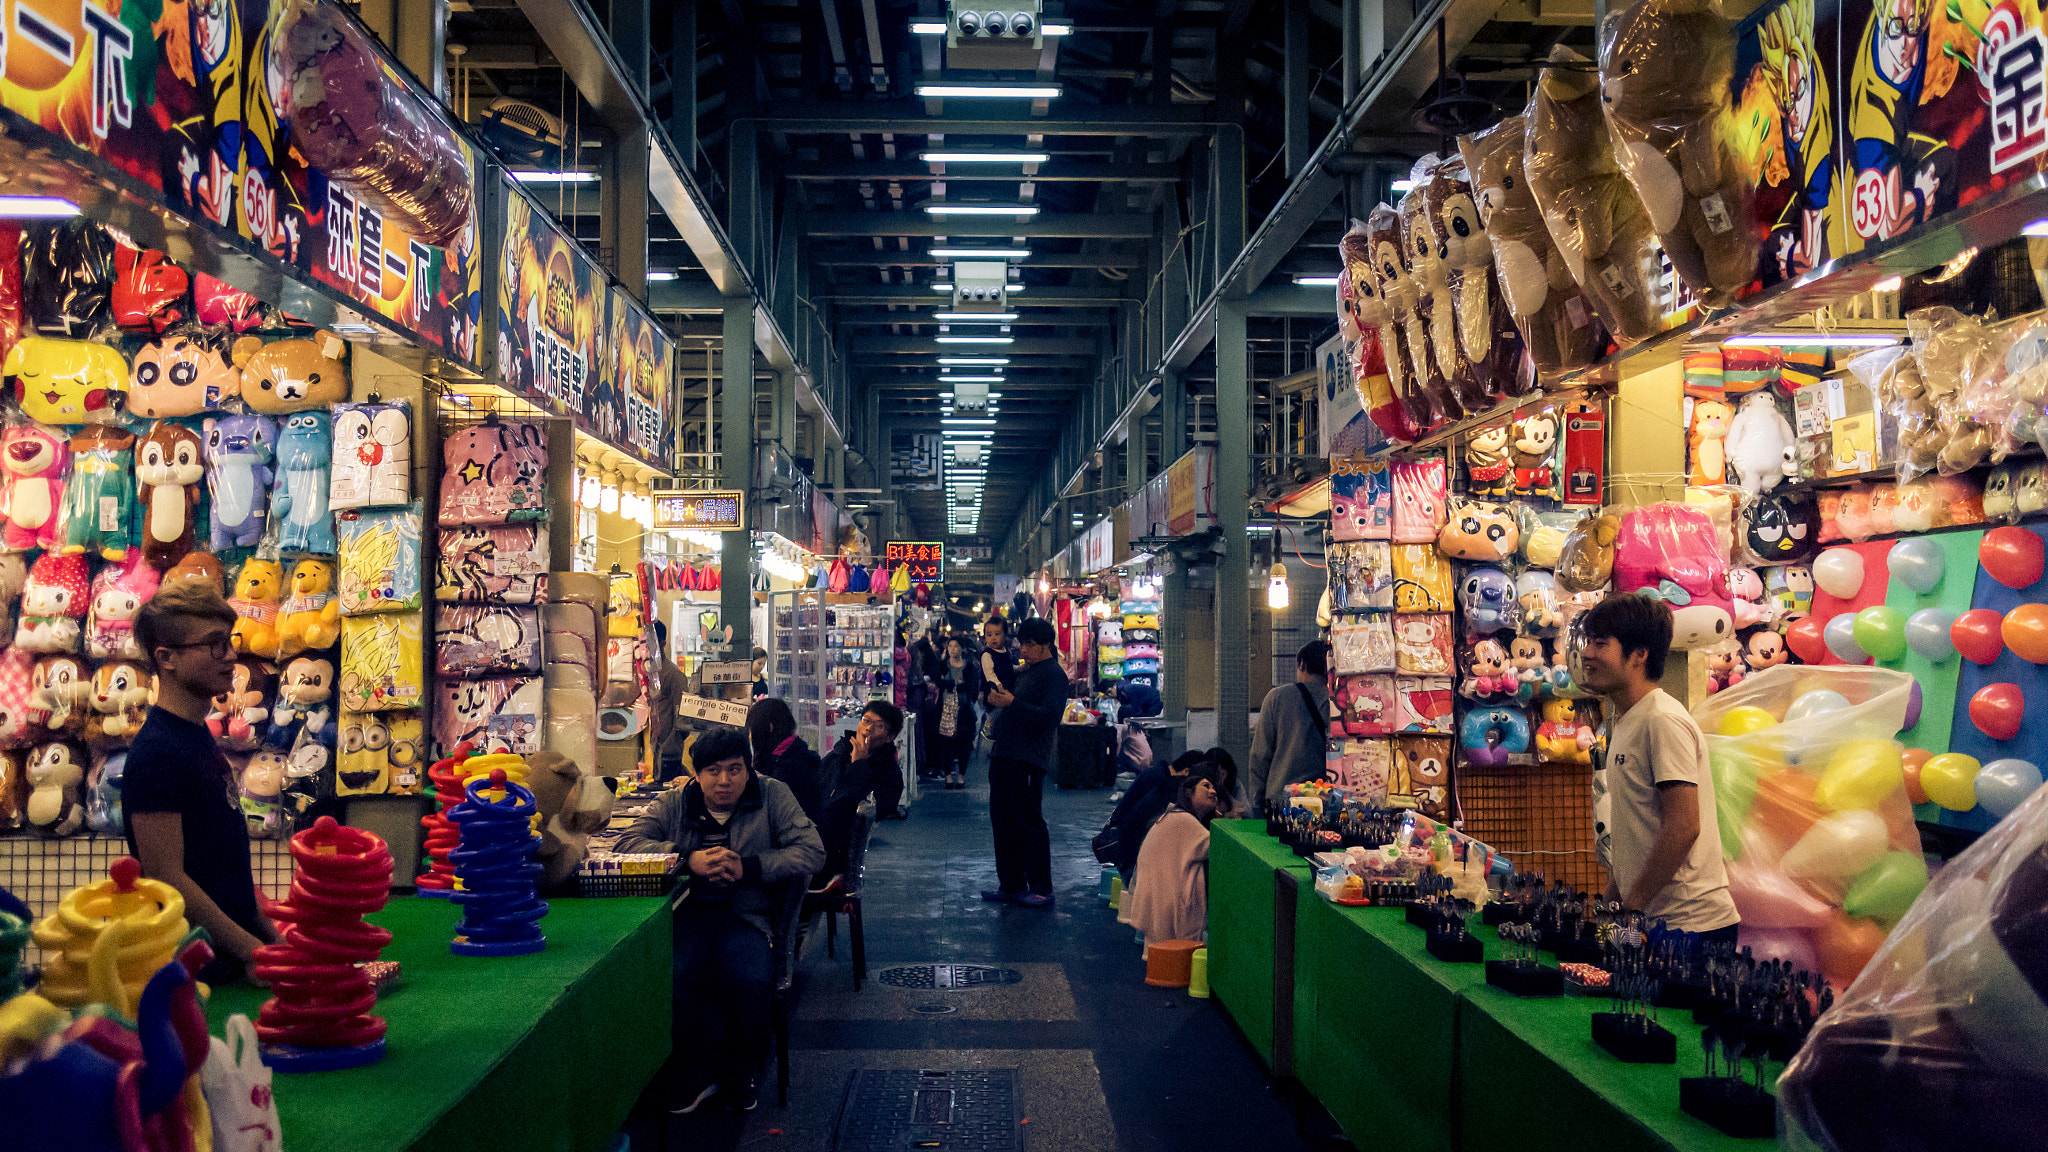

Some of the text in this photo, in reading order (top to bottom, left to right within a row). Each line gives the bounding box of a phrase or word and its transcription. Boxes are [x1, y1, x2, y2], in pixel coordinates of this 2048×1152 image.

[0, 0, 132, 139] 一下
[247, 176, 264, 229] 56
[1857, 178, 1881, 231] 53
[533, 325, 584, 415] 麻將賓果
[657, 499, 685, 522] 15張
[1655, 521, 1699, 534] Meody
[889, 543, 943, 561] B1美食區
[684, 697, 747, 715] Temple Street
